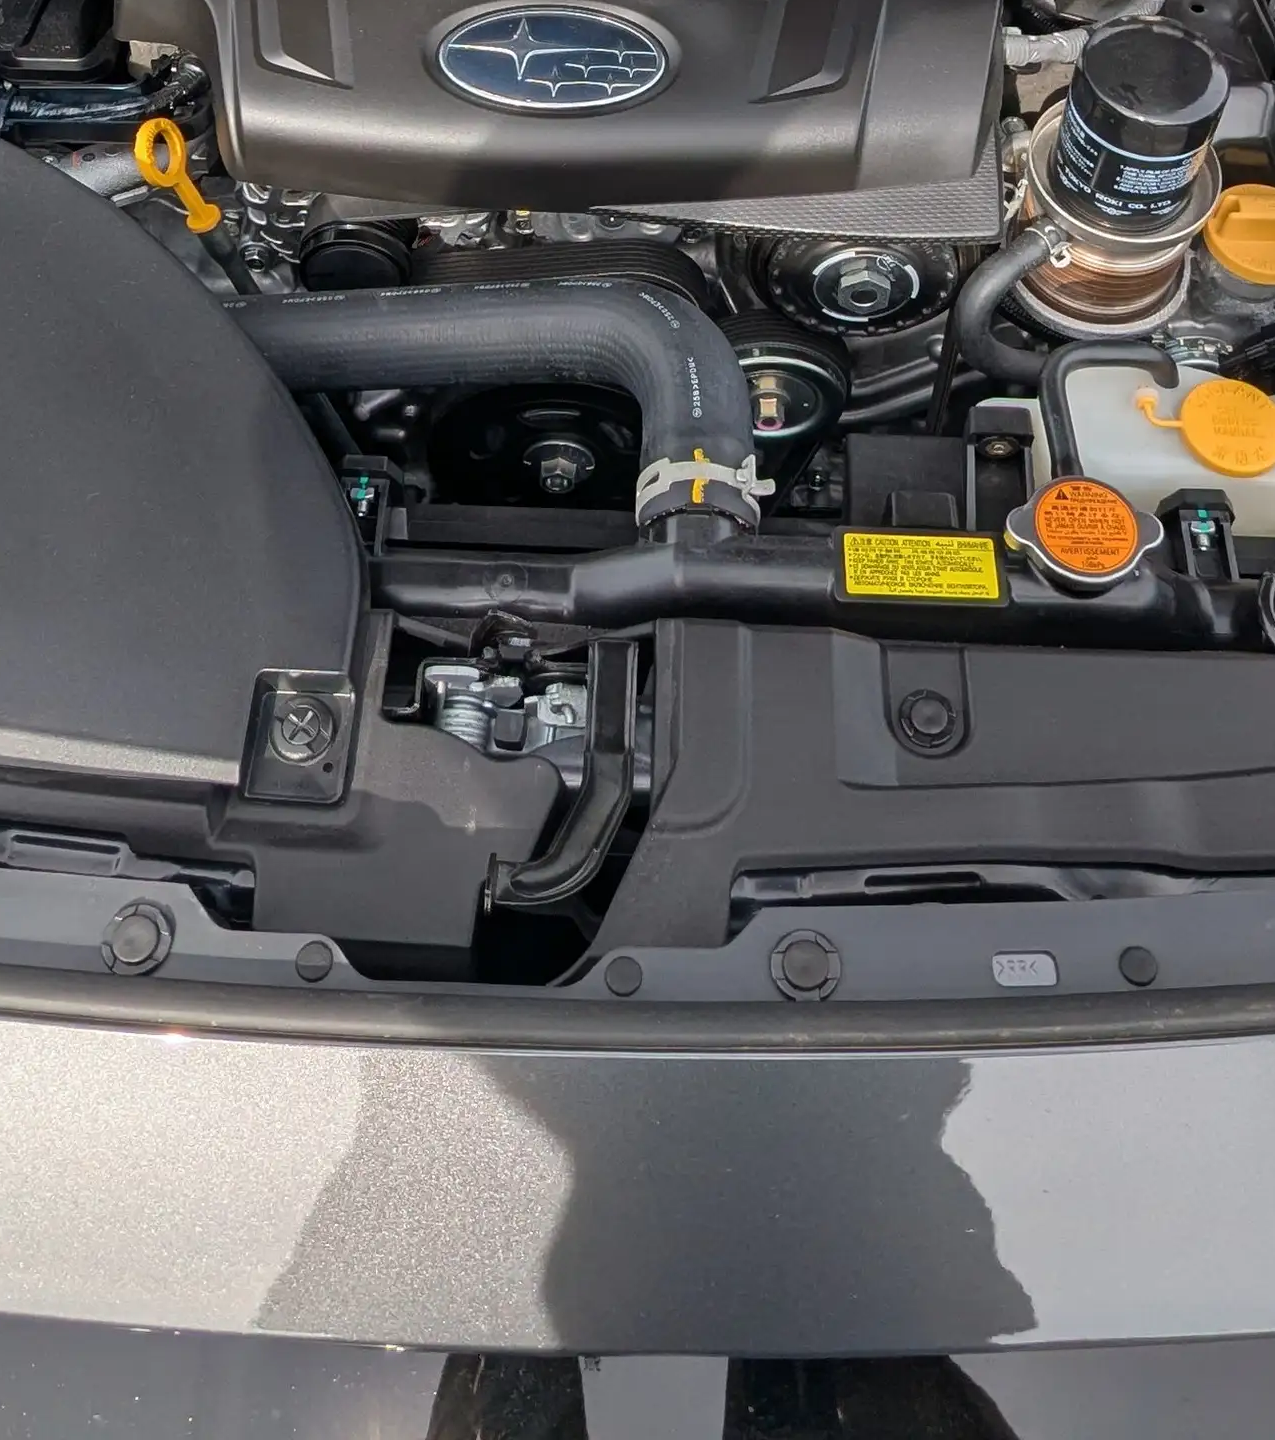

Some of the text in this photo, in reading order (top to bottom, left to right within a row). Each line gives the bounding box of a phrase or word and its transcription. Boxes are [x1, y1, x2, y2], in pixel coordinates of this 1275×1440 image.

[1095, 192, 1123, 207] ROKI
[873, 537, 931, 547] CAUTION ATTENTION
[1060, 547, 1120, 556] AVERTISSEMENT
